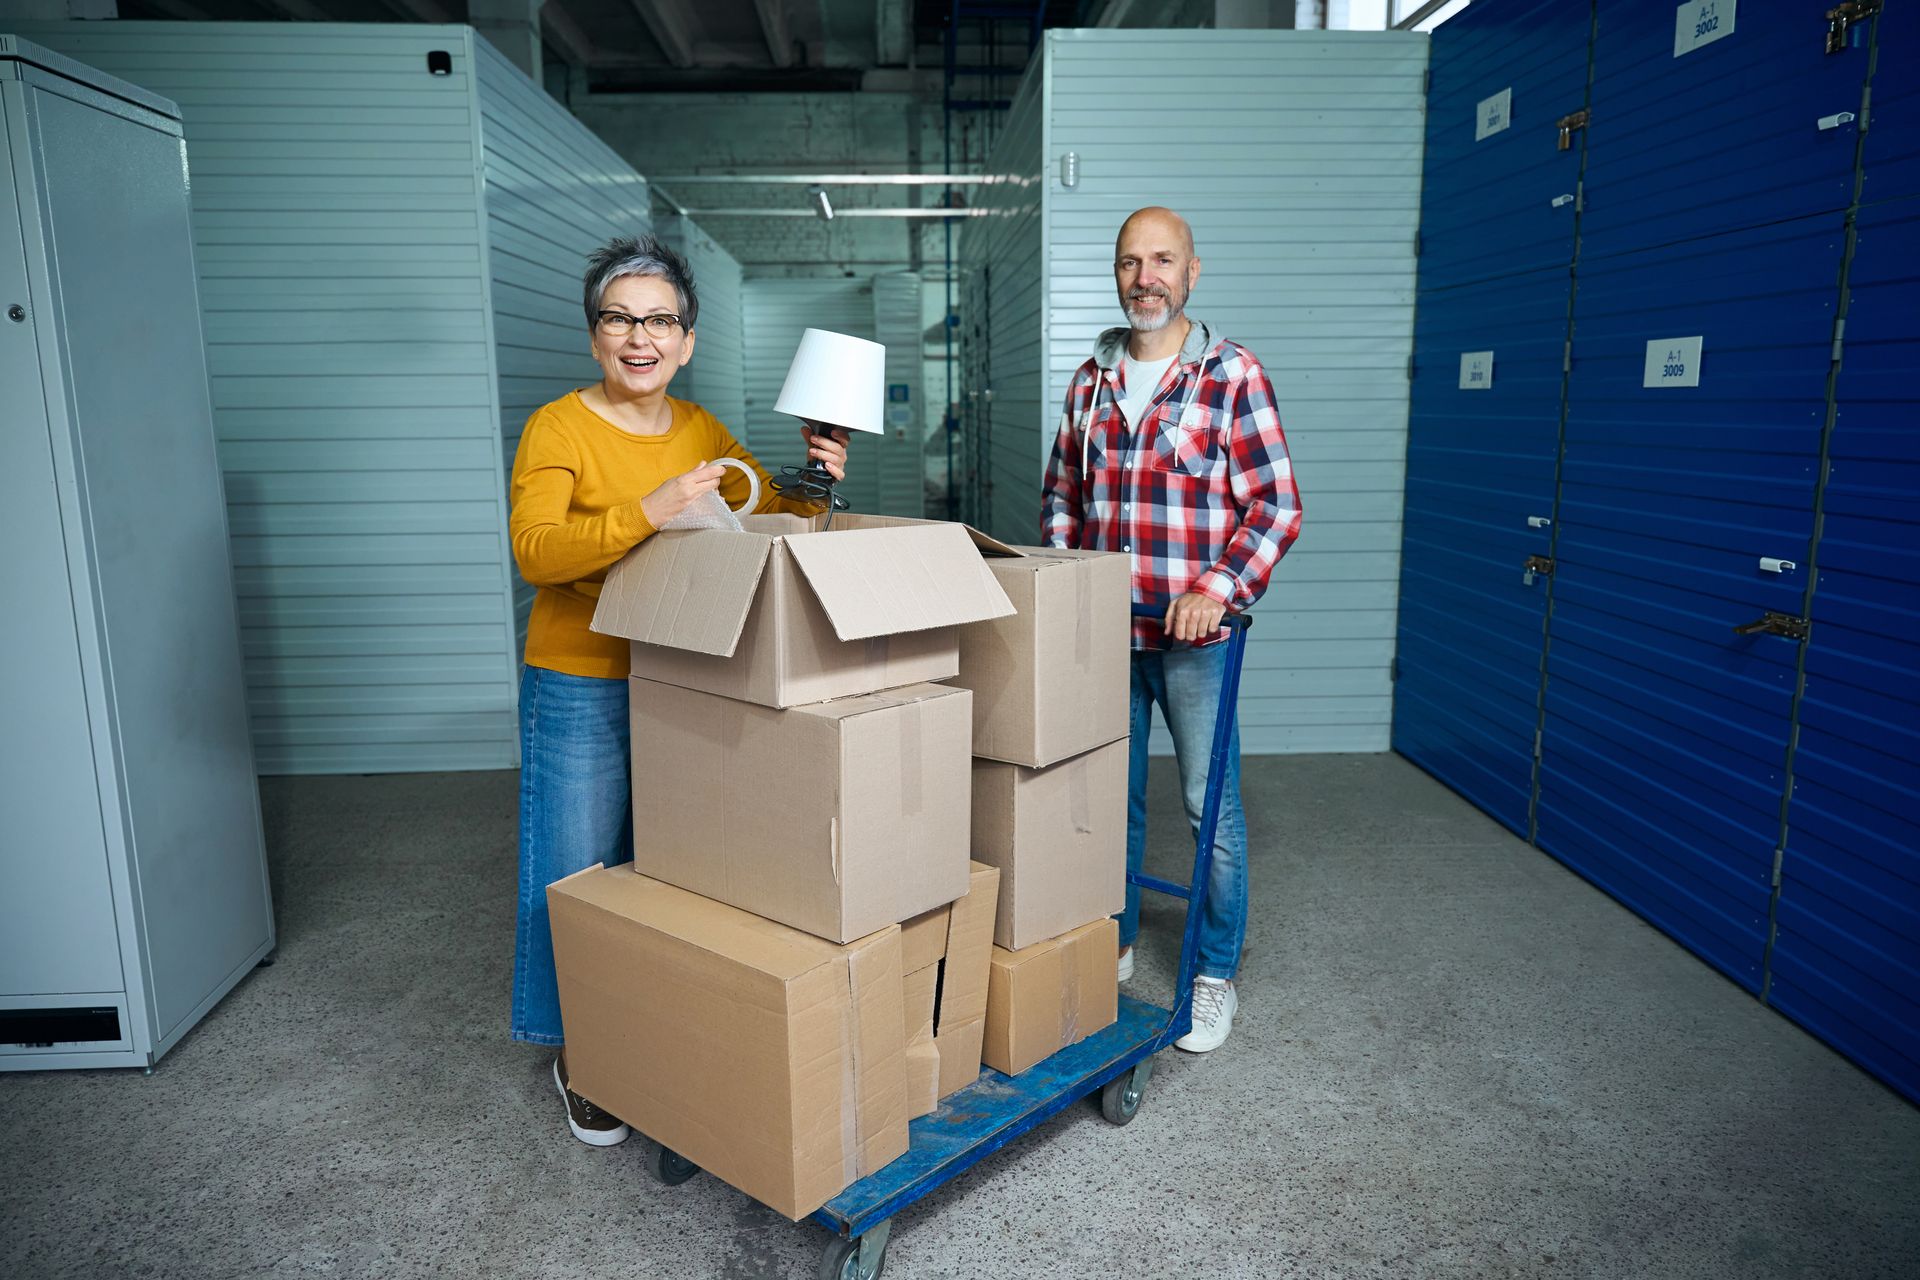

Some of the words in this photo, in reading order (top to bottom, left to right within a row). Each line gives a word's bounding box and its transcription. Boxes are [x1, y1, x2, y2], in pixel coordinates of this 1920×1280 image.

[1699, 2, 1715, 20] A-1
[1694, 16, 1719, 38] 3002
[1667, 349, 1681, 362] A-1
[1663, 364, 1684, 377] 3009
